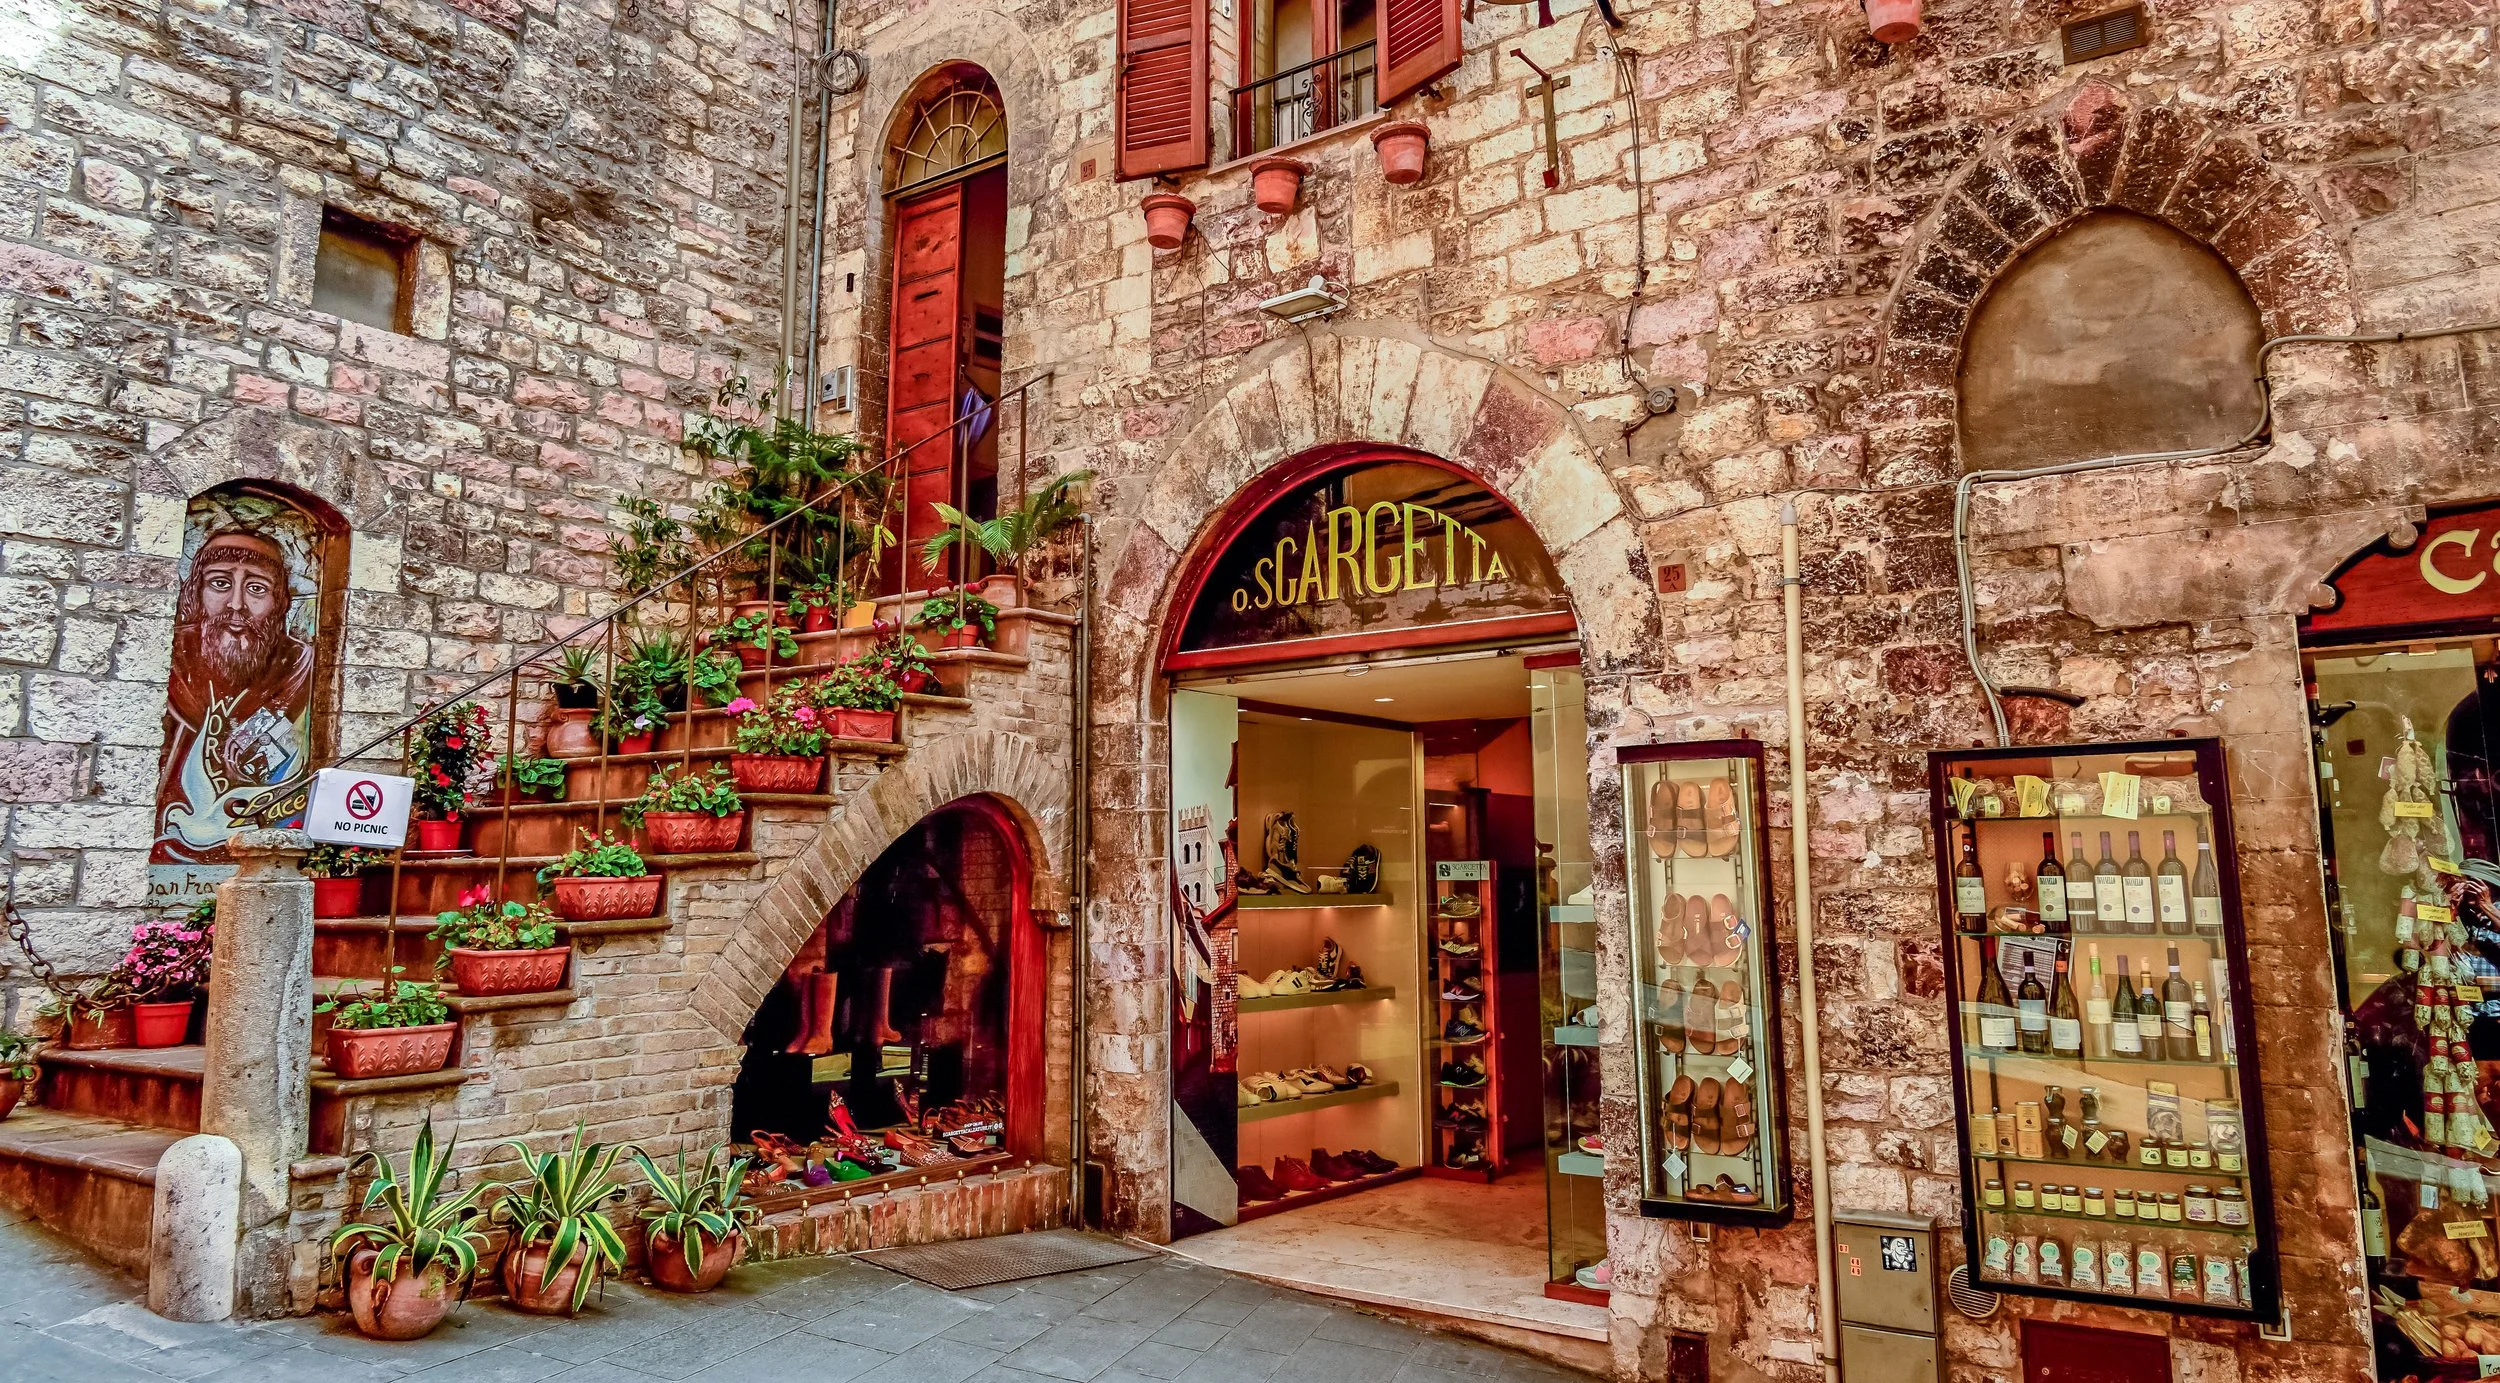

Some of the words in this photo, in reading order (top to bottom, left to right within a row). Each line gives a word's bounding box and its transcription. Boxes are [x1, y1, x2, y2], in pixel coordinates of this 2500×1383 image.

[1083, 164, 1093, 178] 25
[1663, 565, 1680, 582] 25
[1668, 582, 1677, 591] A
[204, 679, 249, 795] WORLD
[229, 792, 306, 828] Pace
[334, 821, 351, 831] NO
[353, 823, 389, 835] PICNIC
